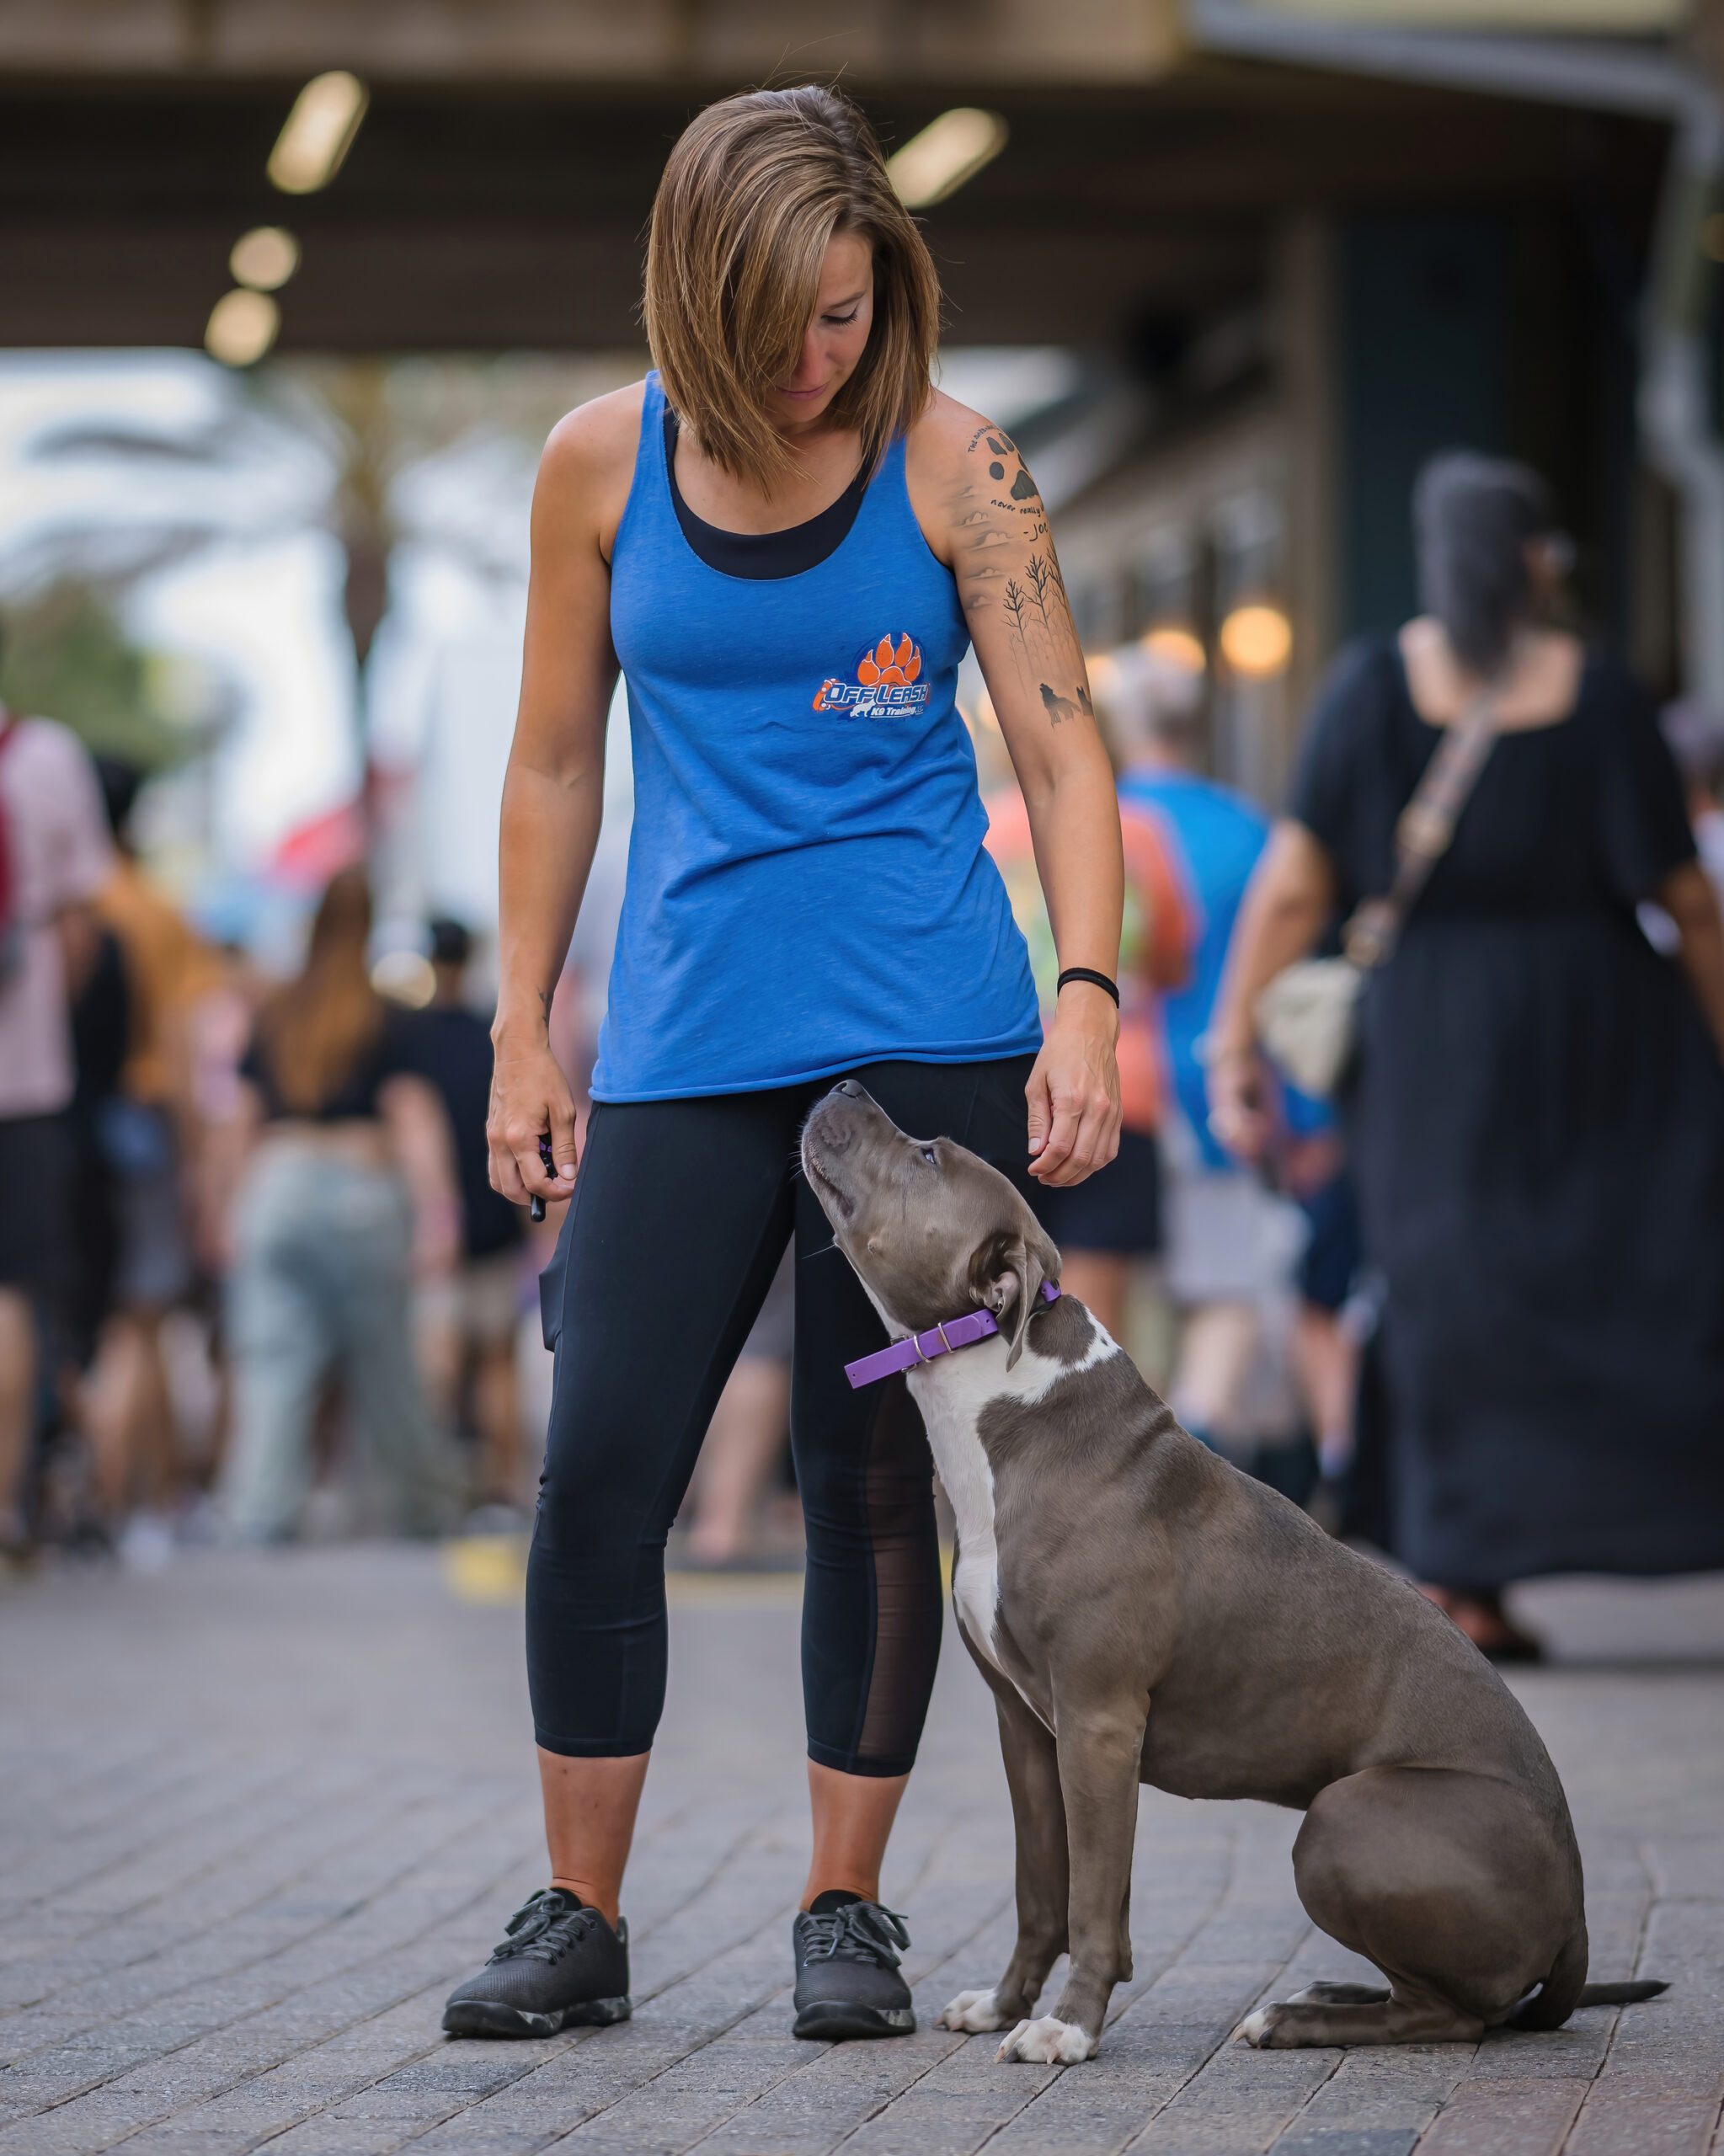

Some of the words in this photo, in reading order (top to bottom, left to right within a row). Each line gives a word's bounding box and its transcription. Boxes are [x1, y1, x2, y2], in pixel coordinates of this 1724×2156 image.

[990, 499, 1016, 512] never
[1020, 507, 1040, 517] really
[870, 707, 885, 716] K9
